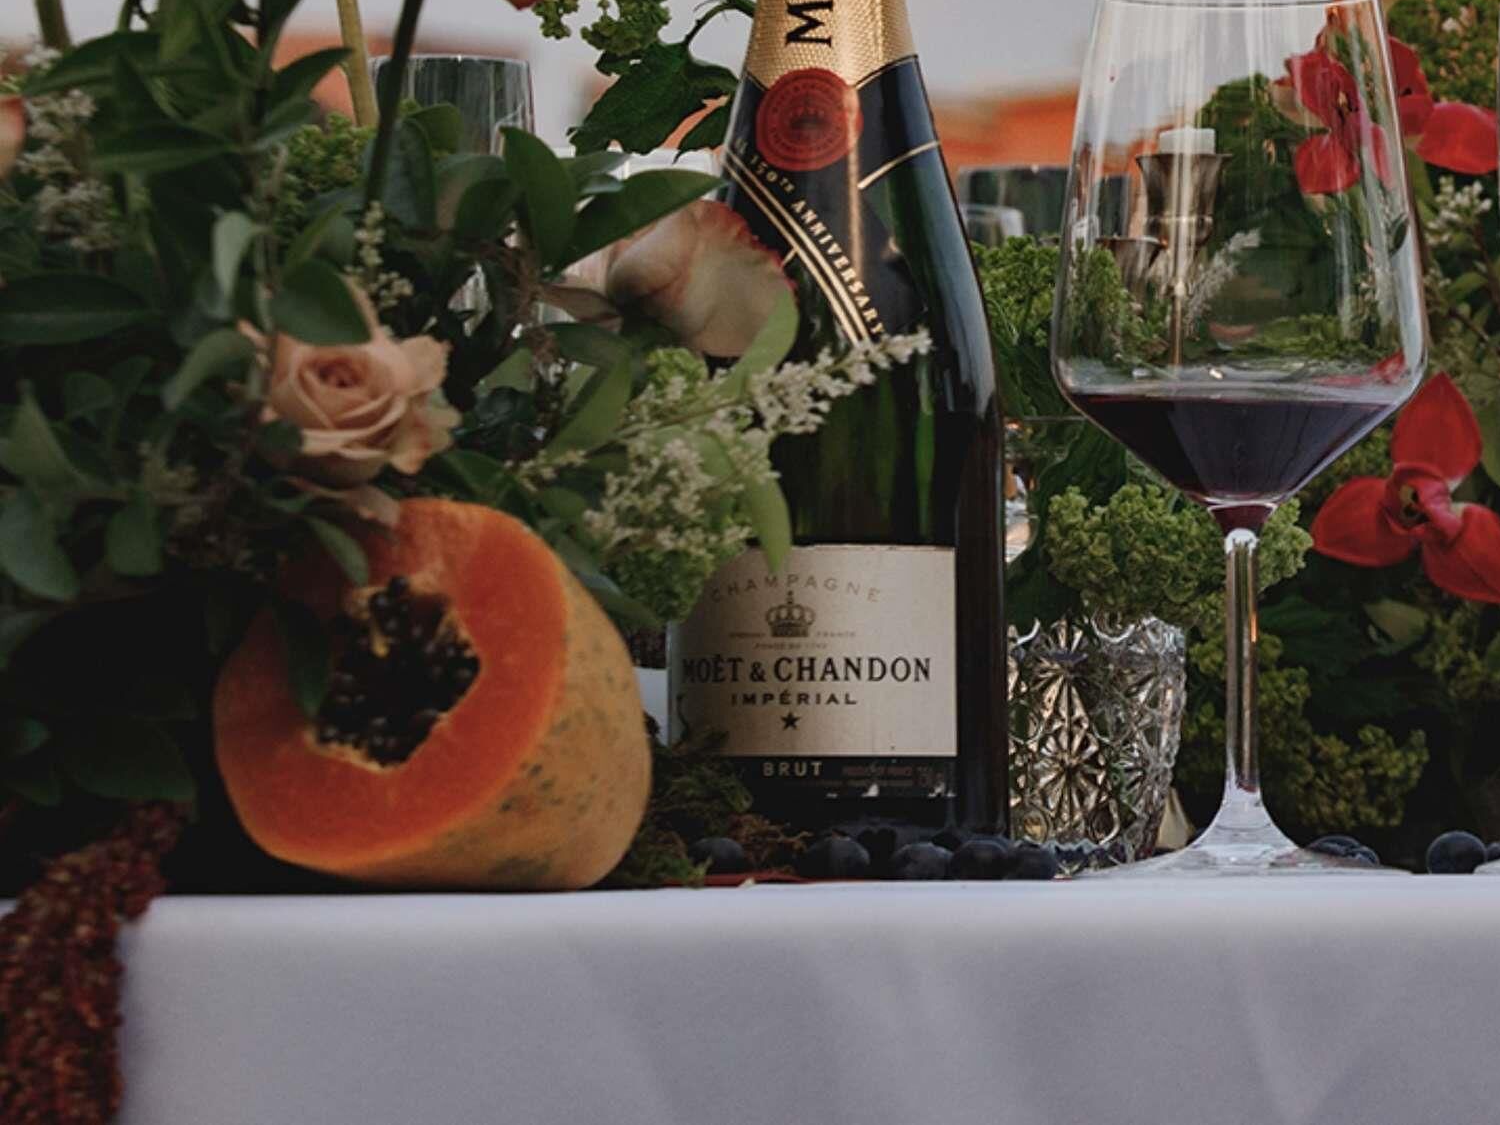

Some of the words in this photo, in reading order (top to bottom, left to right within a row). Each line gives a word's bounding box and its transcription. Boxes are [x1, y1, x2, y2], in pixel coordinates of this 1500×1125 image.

[791, 198, 886, 335] ANNIVERSARY
[712, 573, 881, 603] CHAMPAGNE
[749, 660, 767, 683] &
[773, 656, 931, 683] CHANDON
[731, 688, 858, 706] IMPÉRIAL
[762, 761, 823, 777] BRUT
